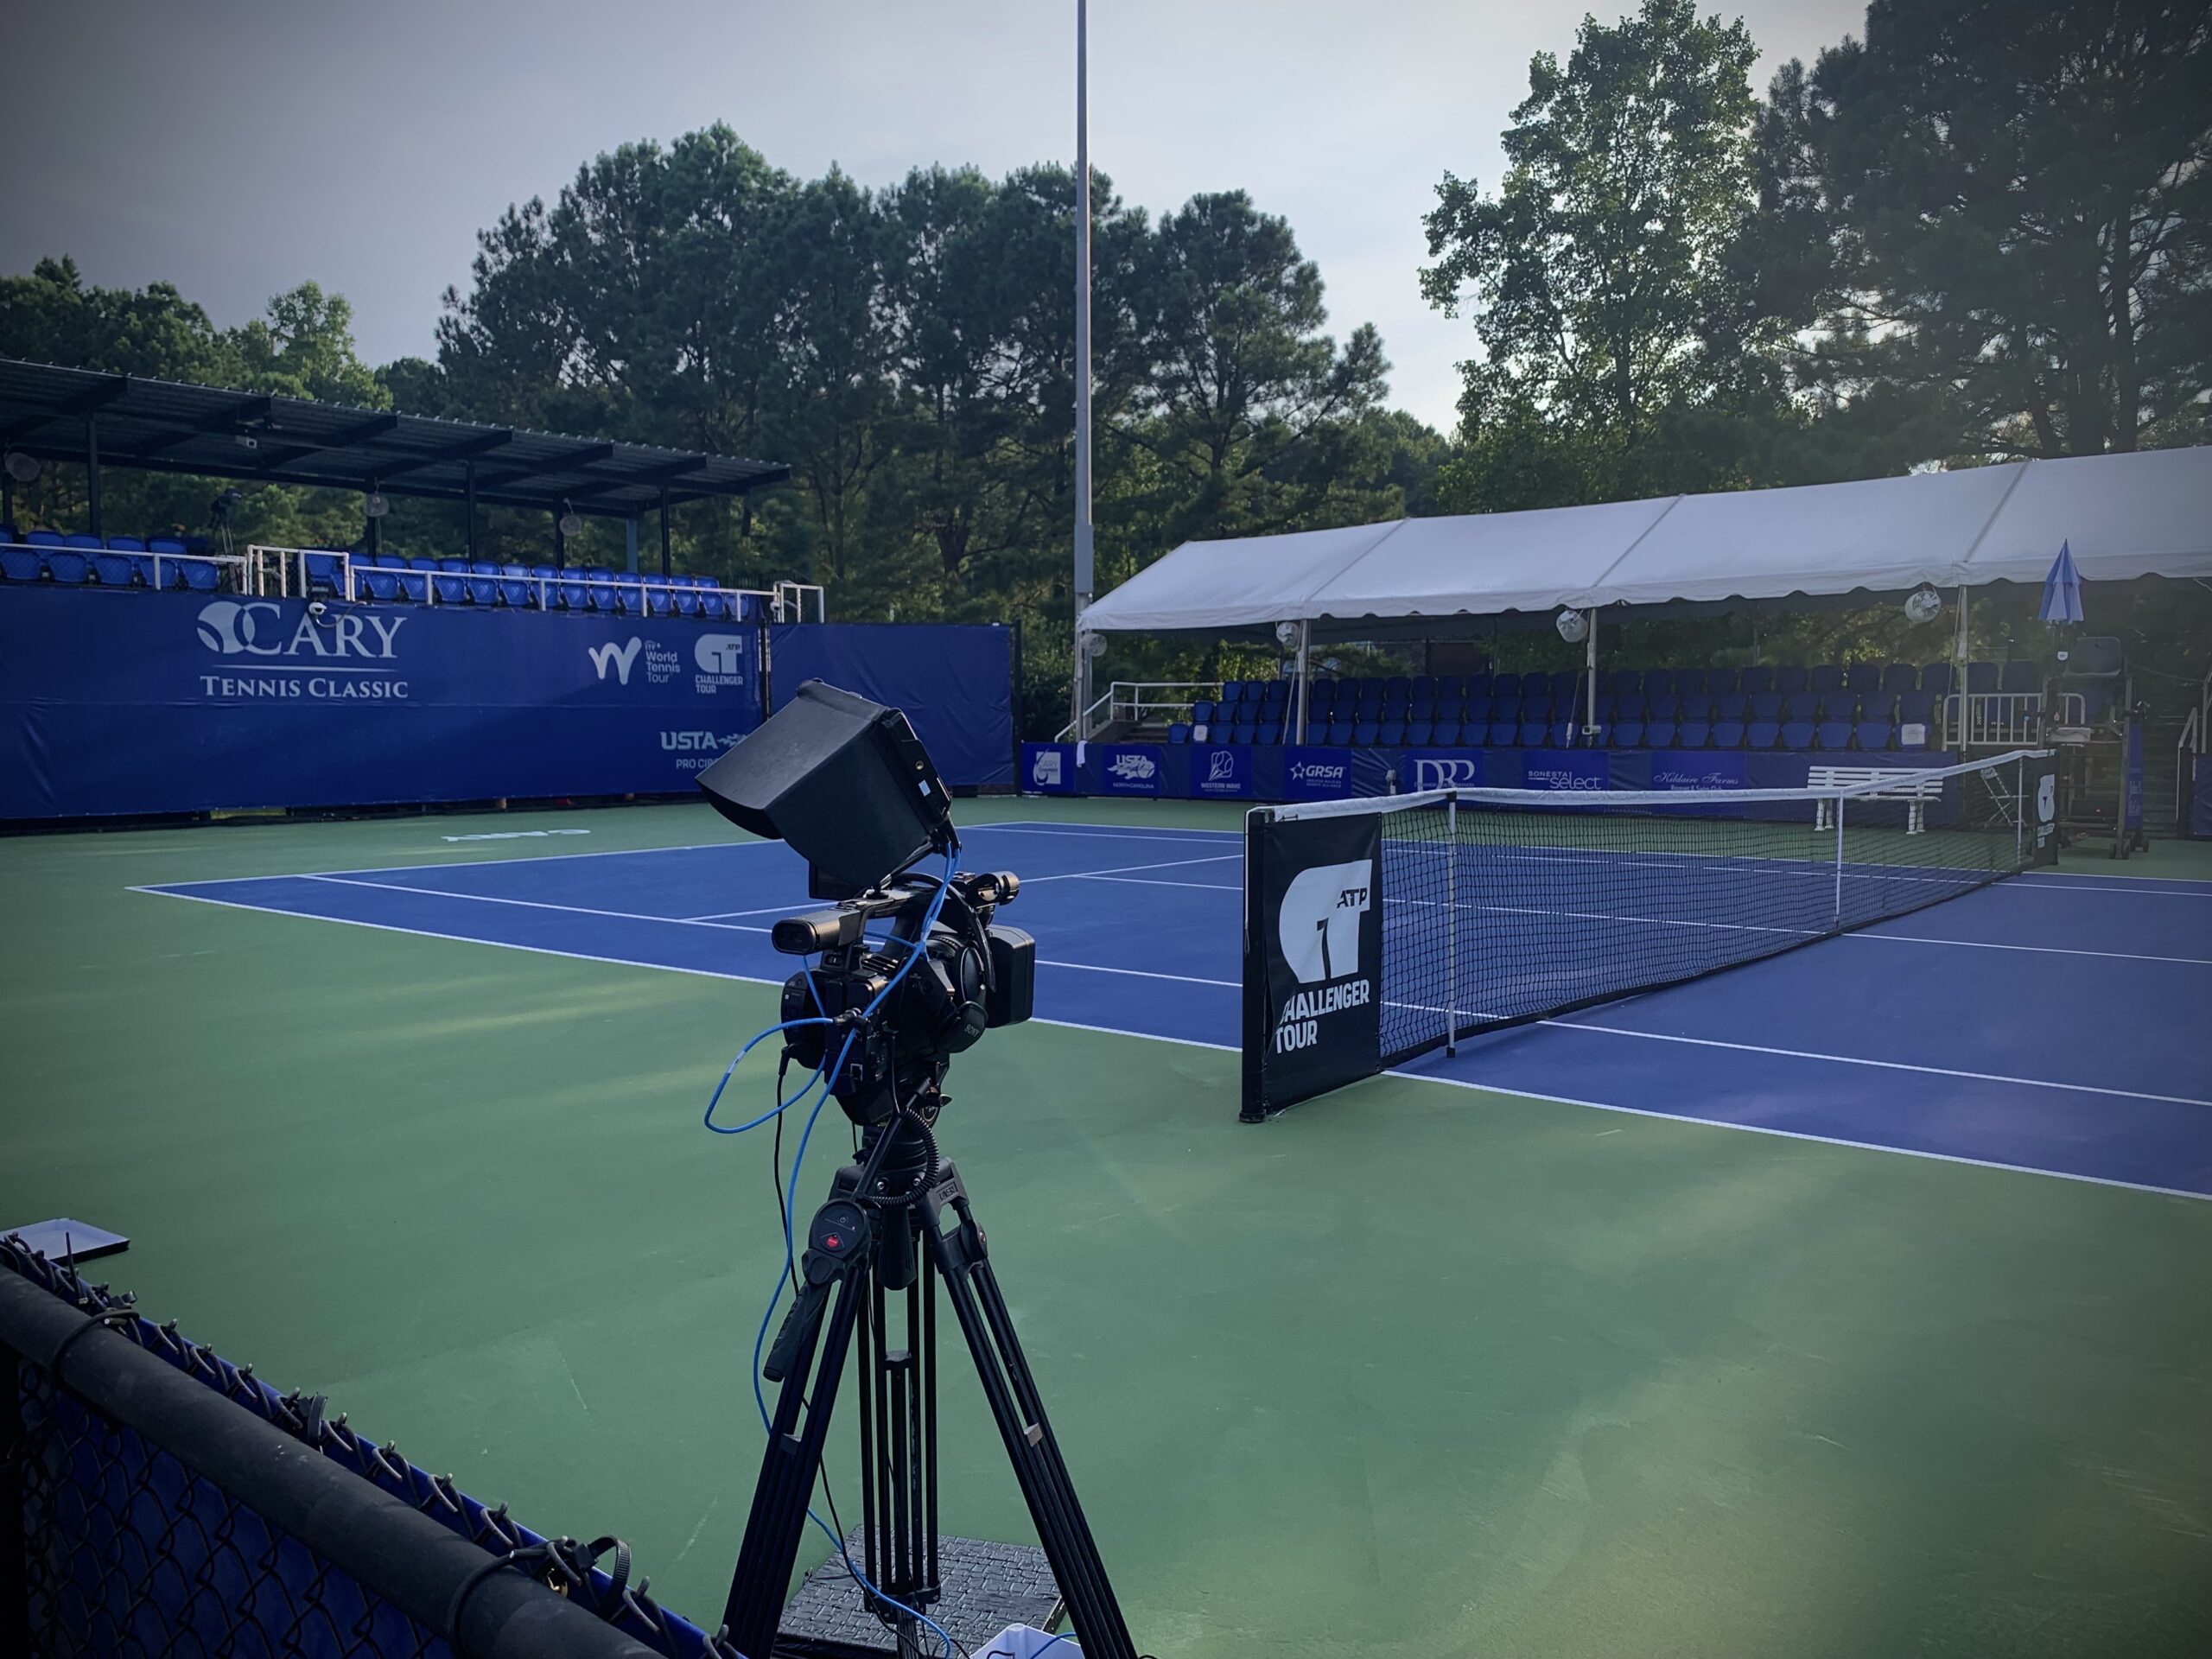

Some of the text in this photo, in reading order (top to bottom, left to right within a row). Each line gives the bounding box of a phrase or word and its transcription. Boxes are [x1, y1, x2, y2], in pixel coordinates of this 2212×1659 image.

[234, 602, 407, 658] CARY
[645, 651, 677, 663] World
[646, 661, 681, 673] Tennis
[646, 671, 670, 683] Tour
[695, 674, 744, 685] CHALLENGER
[200, 676, 408, 698] TENNIS CLASSIC
[695, 683, 717, 694] TOUR
[660, 731, 719, 750] USTA
[676, 759, 720, 769] PRO CIR
[1116, 754, 1148, 766] USTA
[1306, 765, 1344, 779] GRSA
[1653, 772, 1738, 785] Kildaire Farms
[1549, 772, 1603, 790] select
[1337, 887, 1367, 908] ATP
[1276, 1020, 1318, 1054] TOUR
